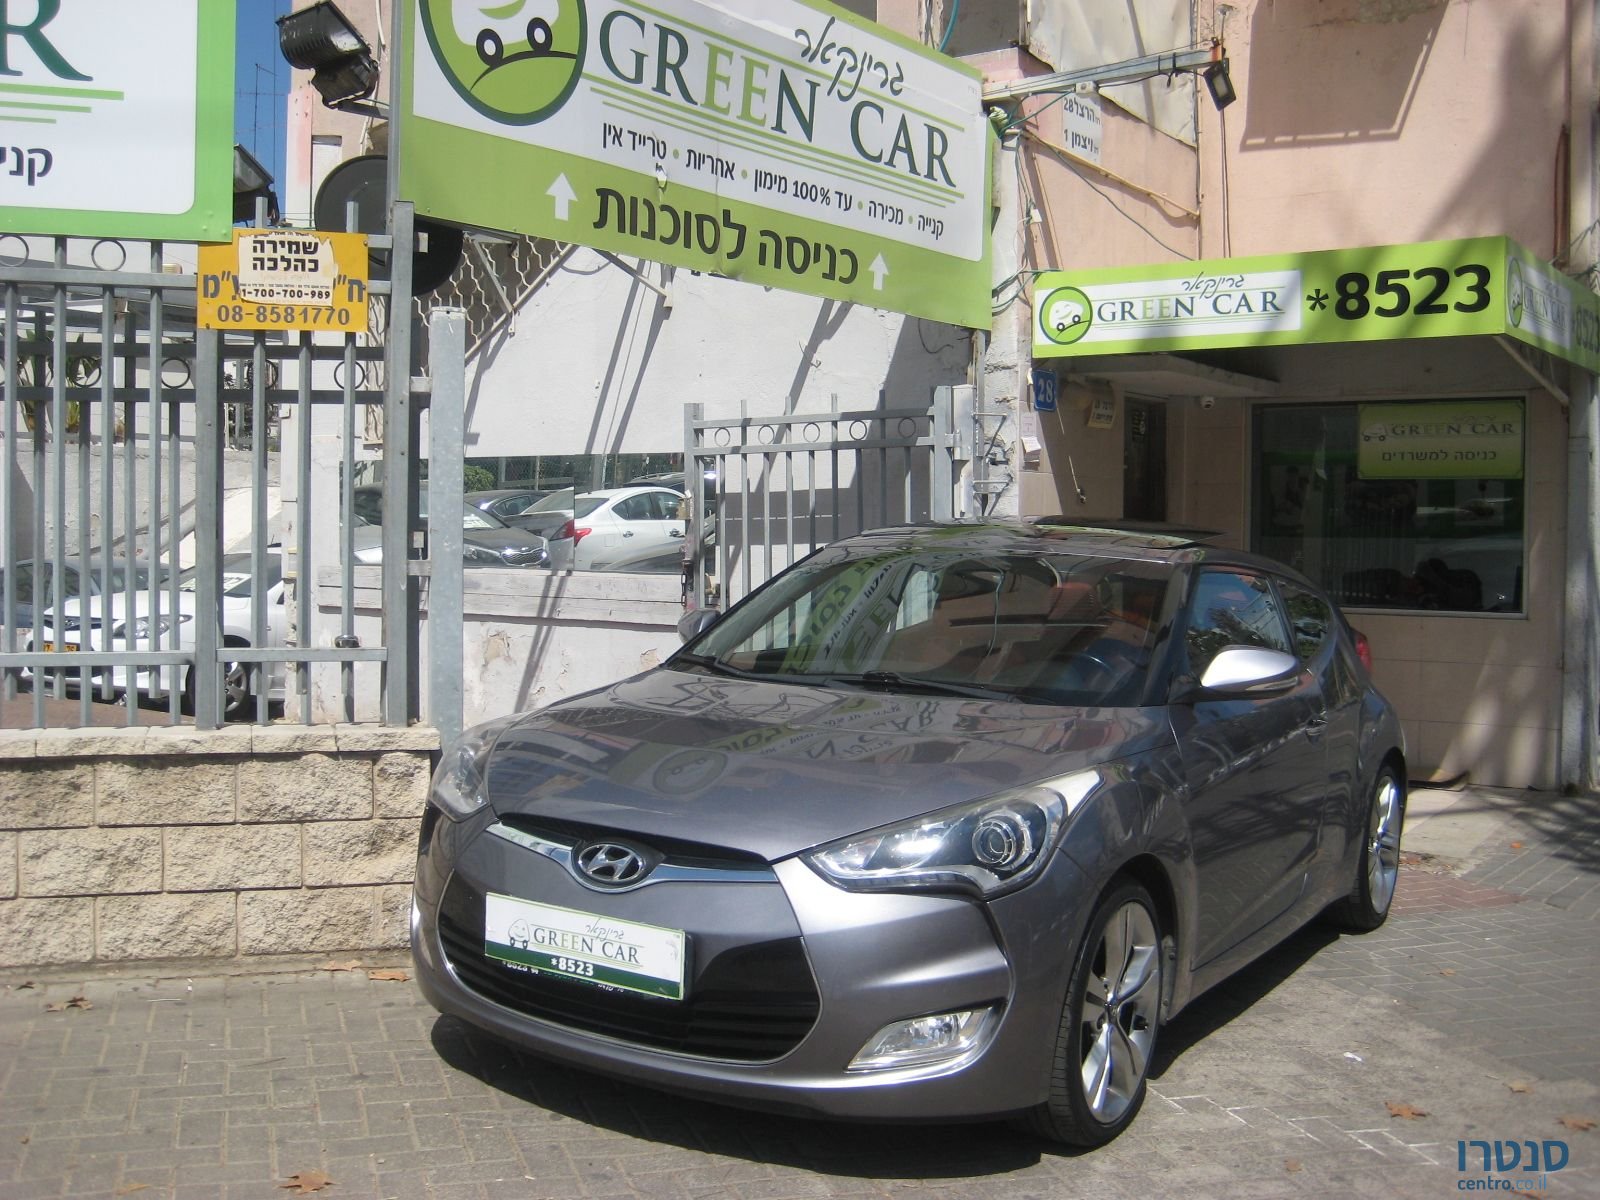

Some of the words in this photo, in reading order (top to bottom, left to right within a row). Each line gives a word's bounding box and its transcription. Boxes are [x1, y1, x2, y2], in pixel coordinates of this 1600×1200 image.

[794, 16, 904, 102] גרינקאר
[600, 10, 821, 143] GREEN
[850, 101, 957, 188] CAR
[602, 123, 623, 149] אין
[627, 129, 667, 160] טרייד
[1071, 131, 1093, 152] ויצמן
[685, 149, 736, 180] אחריות
[754, 169, 788, 194] מימון
[792, 180, 831, 206] 100%
[834, 191, 853, 212] עד
[868, 200, 904, 225] מכירה
[592, 187, 747, 260] לסוכנות
[917, 214, 944, 240] קנייה
[252, 239, 319, 255] שמירה
[758, 229, 859, 285] כניסה
[252, 255, 319, 272] כהלכה
[241, 288, 331, 299] 1-700-700-989
[1181, 271, 1245, 299] גרינקאר
[217, 305, 350, 325] 08-8581770
[1097, 296, 1195, 322] GREEN
[1212, 290, 1283, 315] CAR
[1037, 378, 1053, 403] 28
[1391, 423, 1461, 436] GREEN
[1471, 422, 1514, 435] CAR
[1382, 449, 1449, 461] למשרדים
[1454, 450, 1497, 461] כניסה
[533, 928, 593, 953] GREEN
[602, 941, 640, 964] CAR
